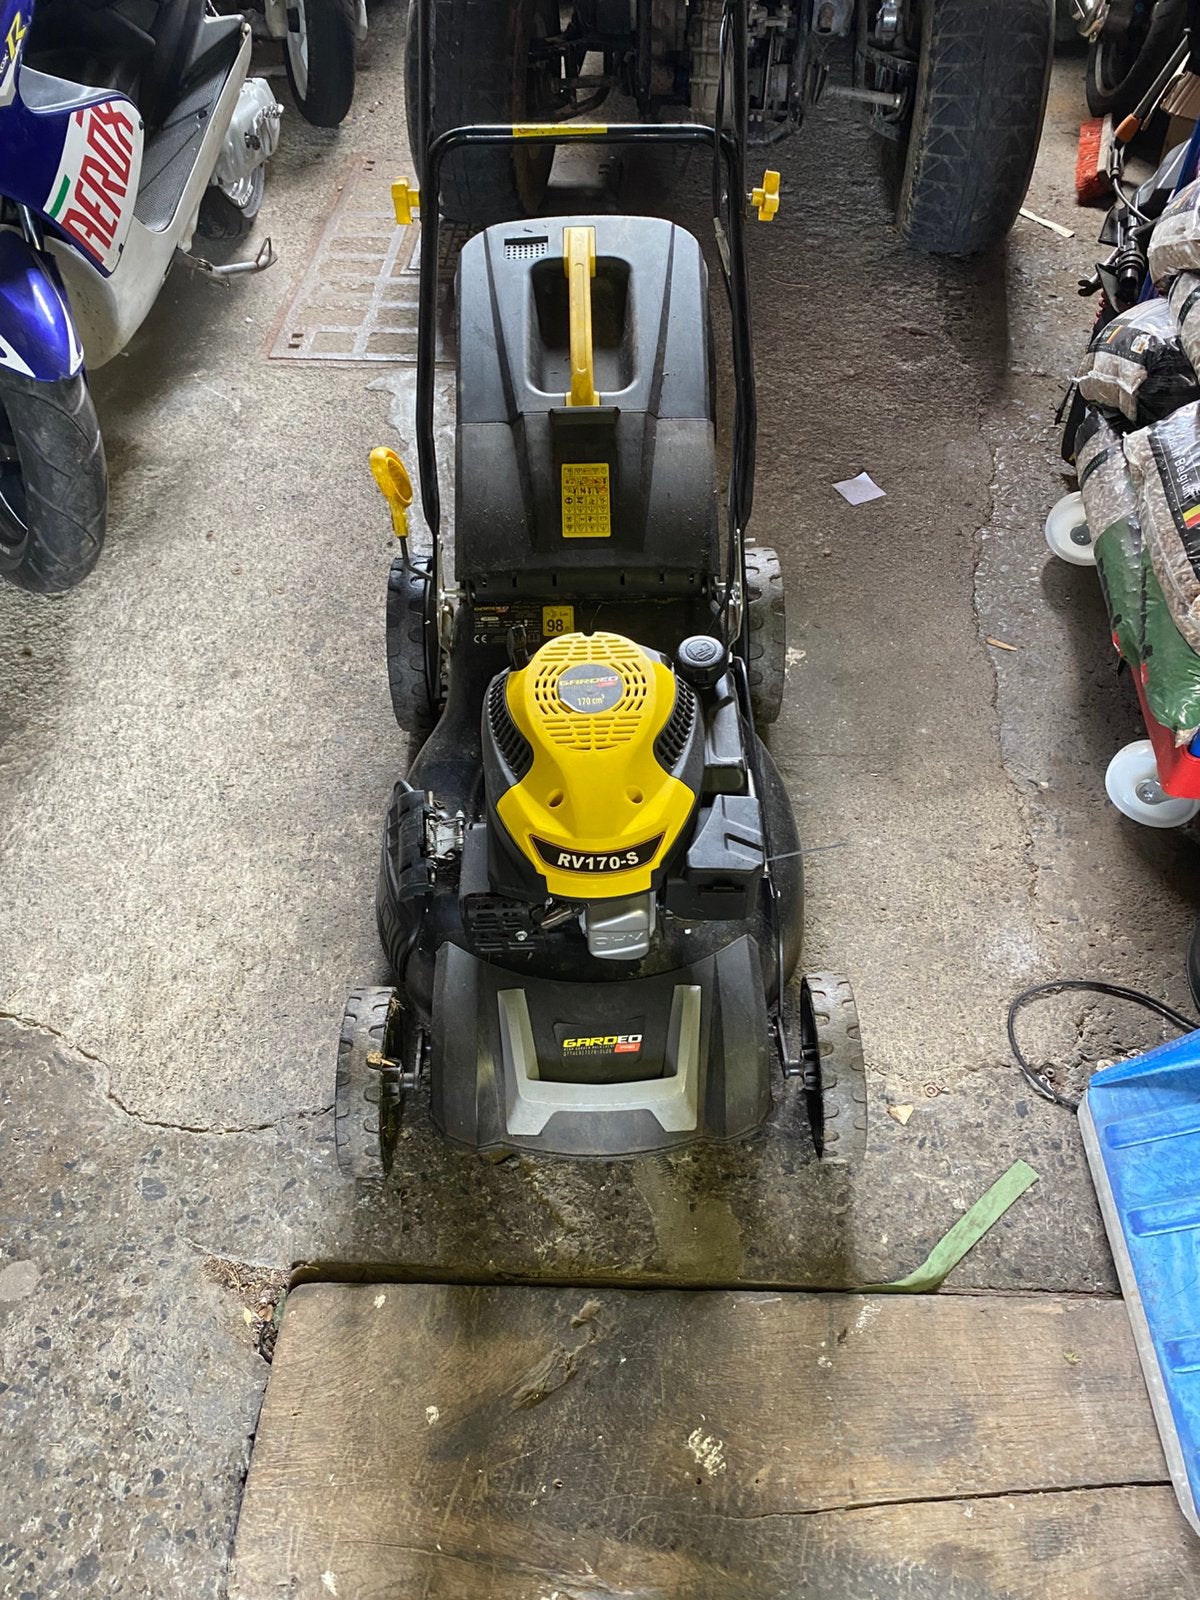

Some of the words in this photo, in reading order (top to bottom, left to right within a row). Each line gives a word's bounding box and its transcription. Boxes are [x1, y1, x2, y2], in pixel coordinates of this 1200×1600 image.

[60, 101, 134, 263] AEROX
[547, 619, 564, 632] 98
[577, 696, 591, 706] 170
[557, 851, 639, 870] RV170-S
[563, 1034, 643, 1048] GARDEO
